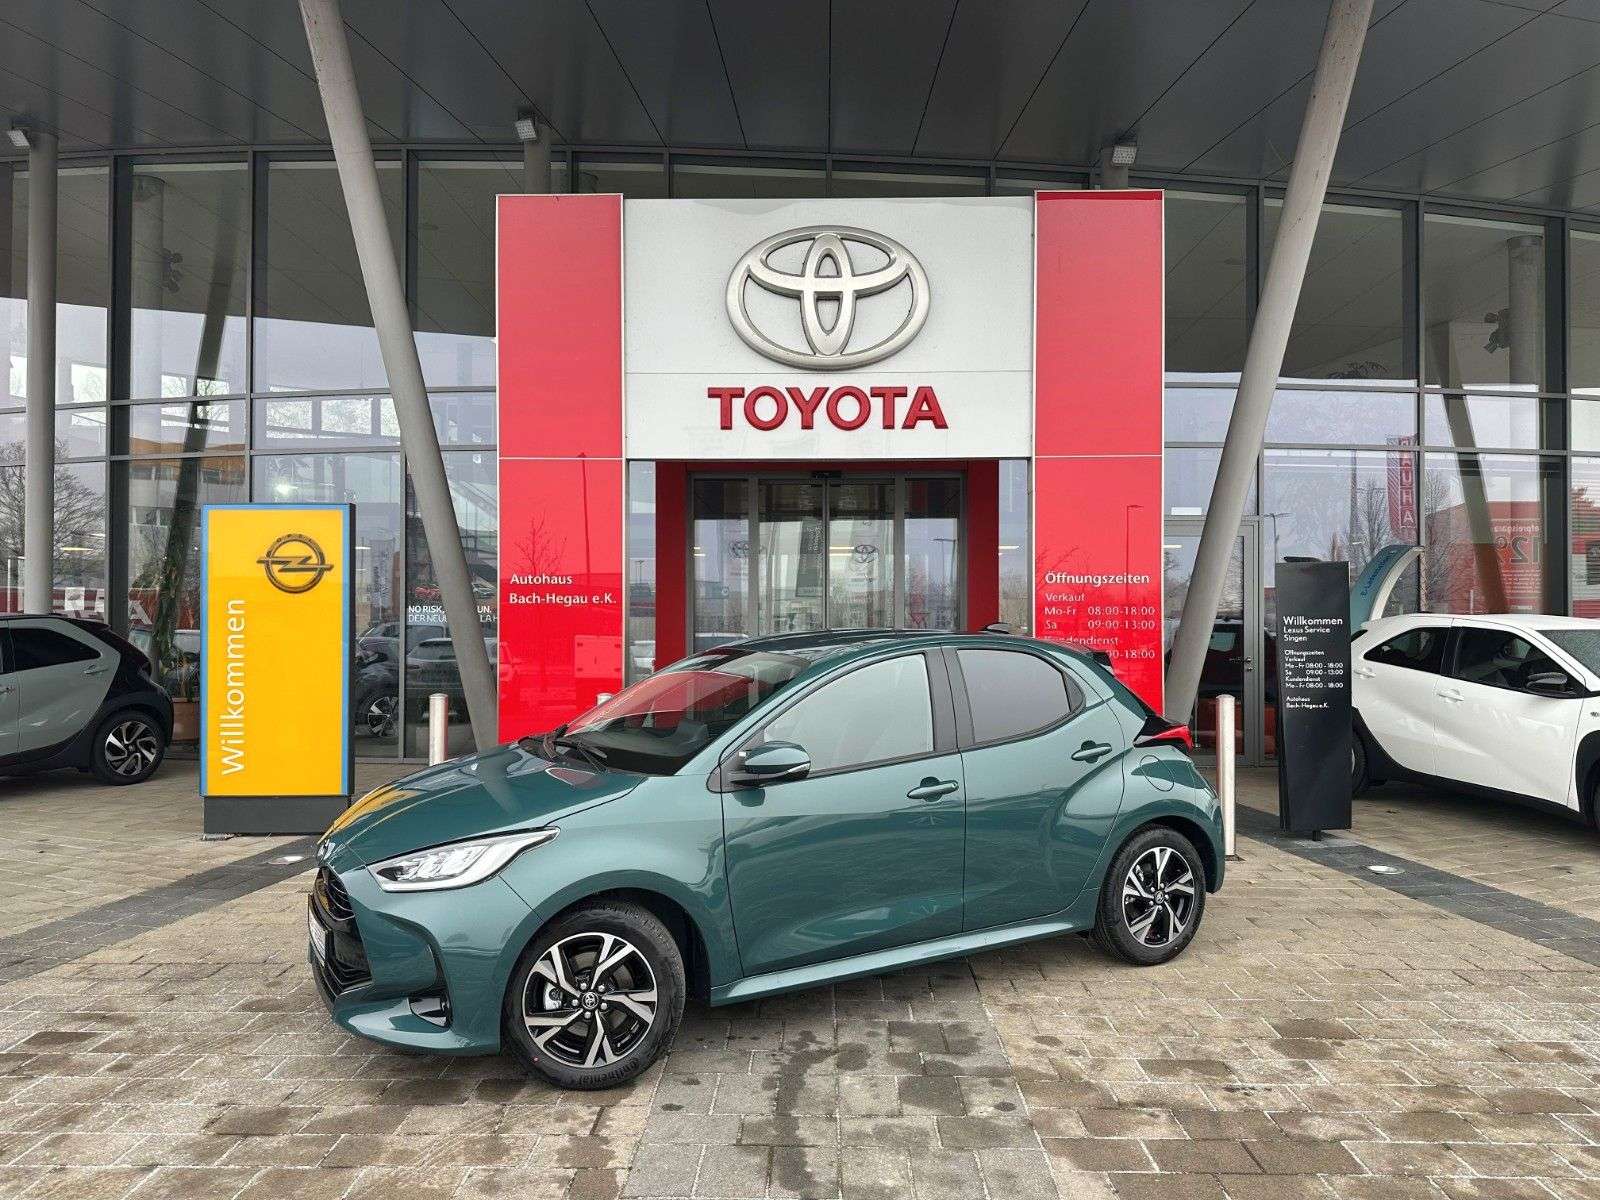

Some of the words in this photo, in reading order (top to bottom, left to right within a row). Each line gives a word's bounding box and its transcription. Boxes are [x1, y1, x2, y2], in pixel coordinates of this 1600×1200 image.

[707, 386, 949, 431] TOYOTA
[510, 573, 573, 585] Autohaus
[1045, 571, 1150, 587] Öffnungszeiten
[509, 592, 588, 607] Bach-Hegau
[592, 593, 617, 604] e.K.
[1045, 593, 1086, 602] Verkauf
[408, 605, 421, 613] NO
[423, 605, 445, 614] RISK,
[477, 605, 492, 613] UN.
[1044, 606, 1077, 616] Mo-Fr
[1087, 606, 1155, 616] 08:00-18:00
[1045, 620, 1057, 630] Sa
[1087, 620, 1155, 630] 09:00-13:00
[1282, 615, 1343, 625] Willkommen
[1044, 636, 1118, 645] dendienst
[1283, 634, 1308, 642] Singen
[219, 599, 246, 776] Willkommen
